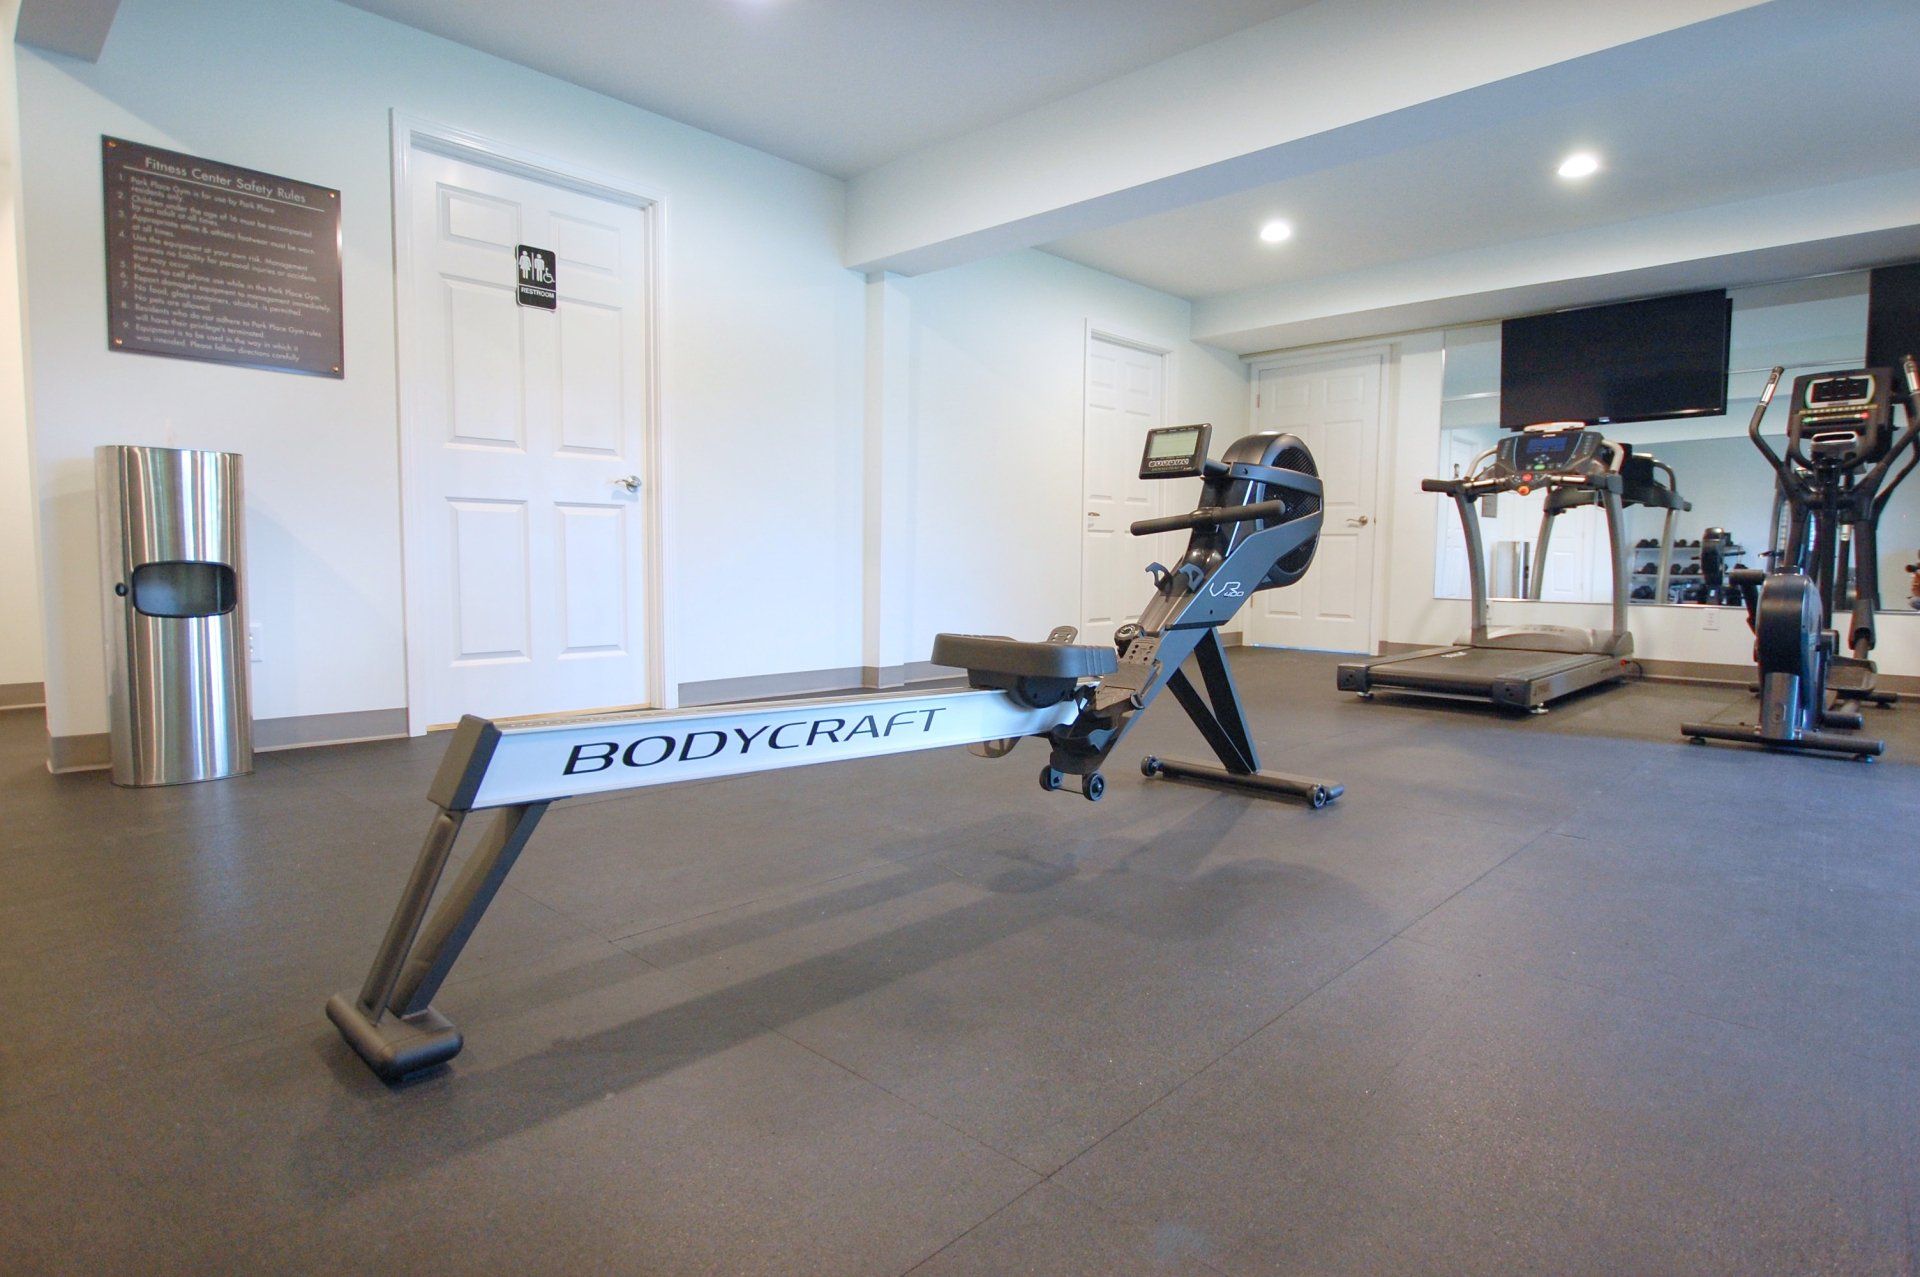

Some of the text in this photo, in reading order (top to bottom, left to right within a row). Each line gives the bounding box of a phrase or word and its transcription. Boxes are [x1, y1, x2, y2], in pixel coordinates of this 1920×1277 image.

[145, 157, 305, 203] Fitness Center Safety Rules
[521, 287, 555, 298] RESTROOM
[562, 708, 946, 775] BODYCRAFT
